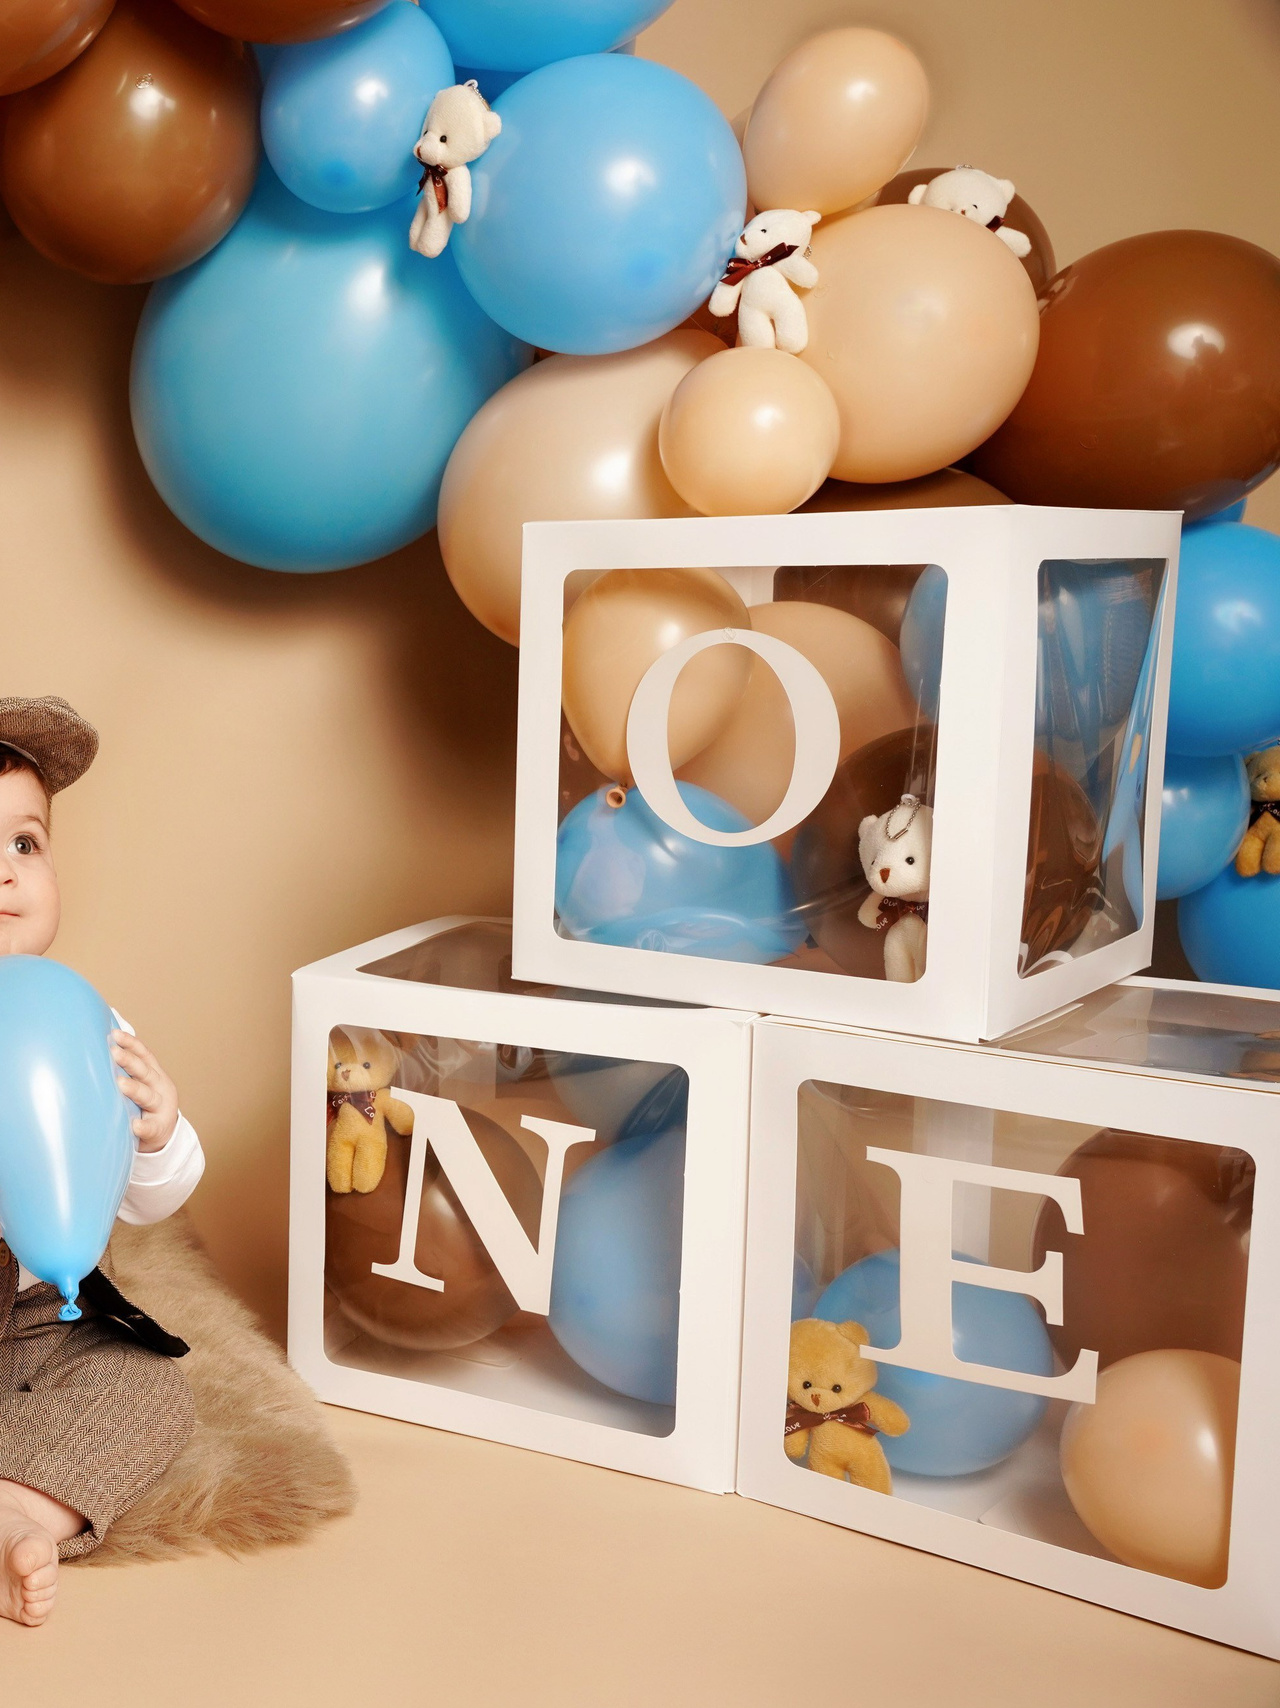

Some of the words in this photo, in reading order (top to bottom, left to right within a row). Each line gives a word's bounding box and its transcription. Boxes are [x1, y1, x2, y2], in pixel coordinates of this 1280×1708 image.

[626, 628, 841, 847] O
[371, 1086, 596, 1316] N
[860, 1146, 1099, 1406] E
